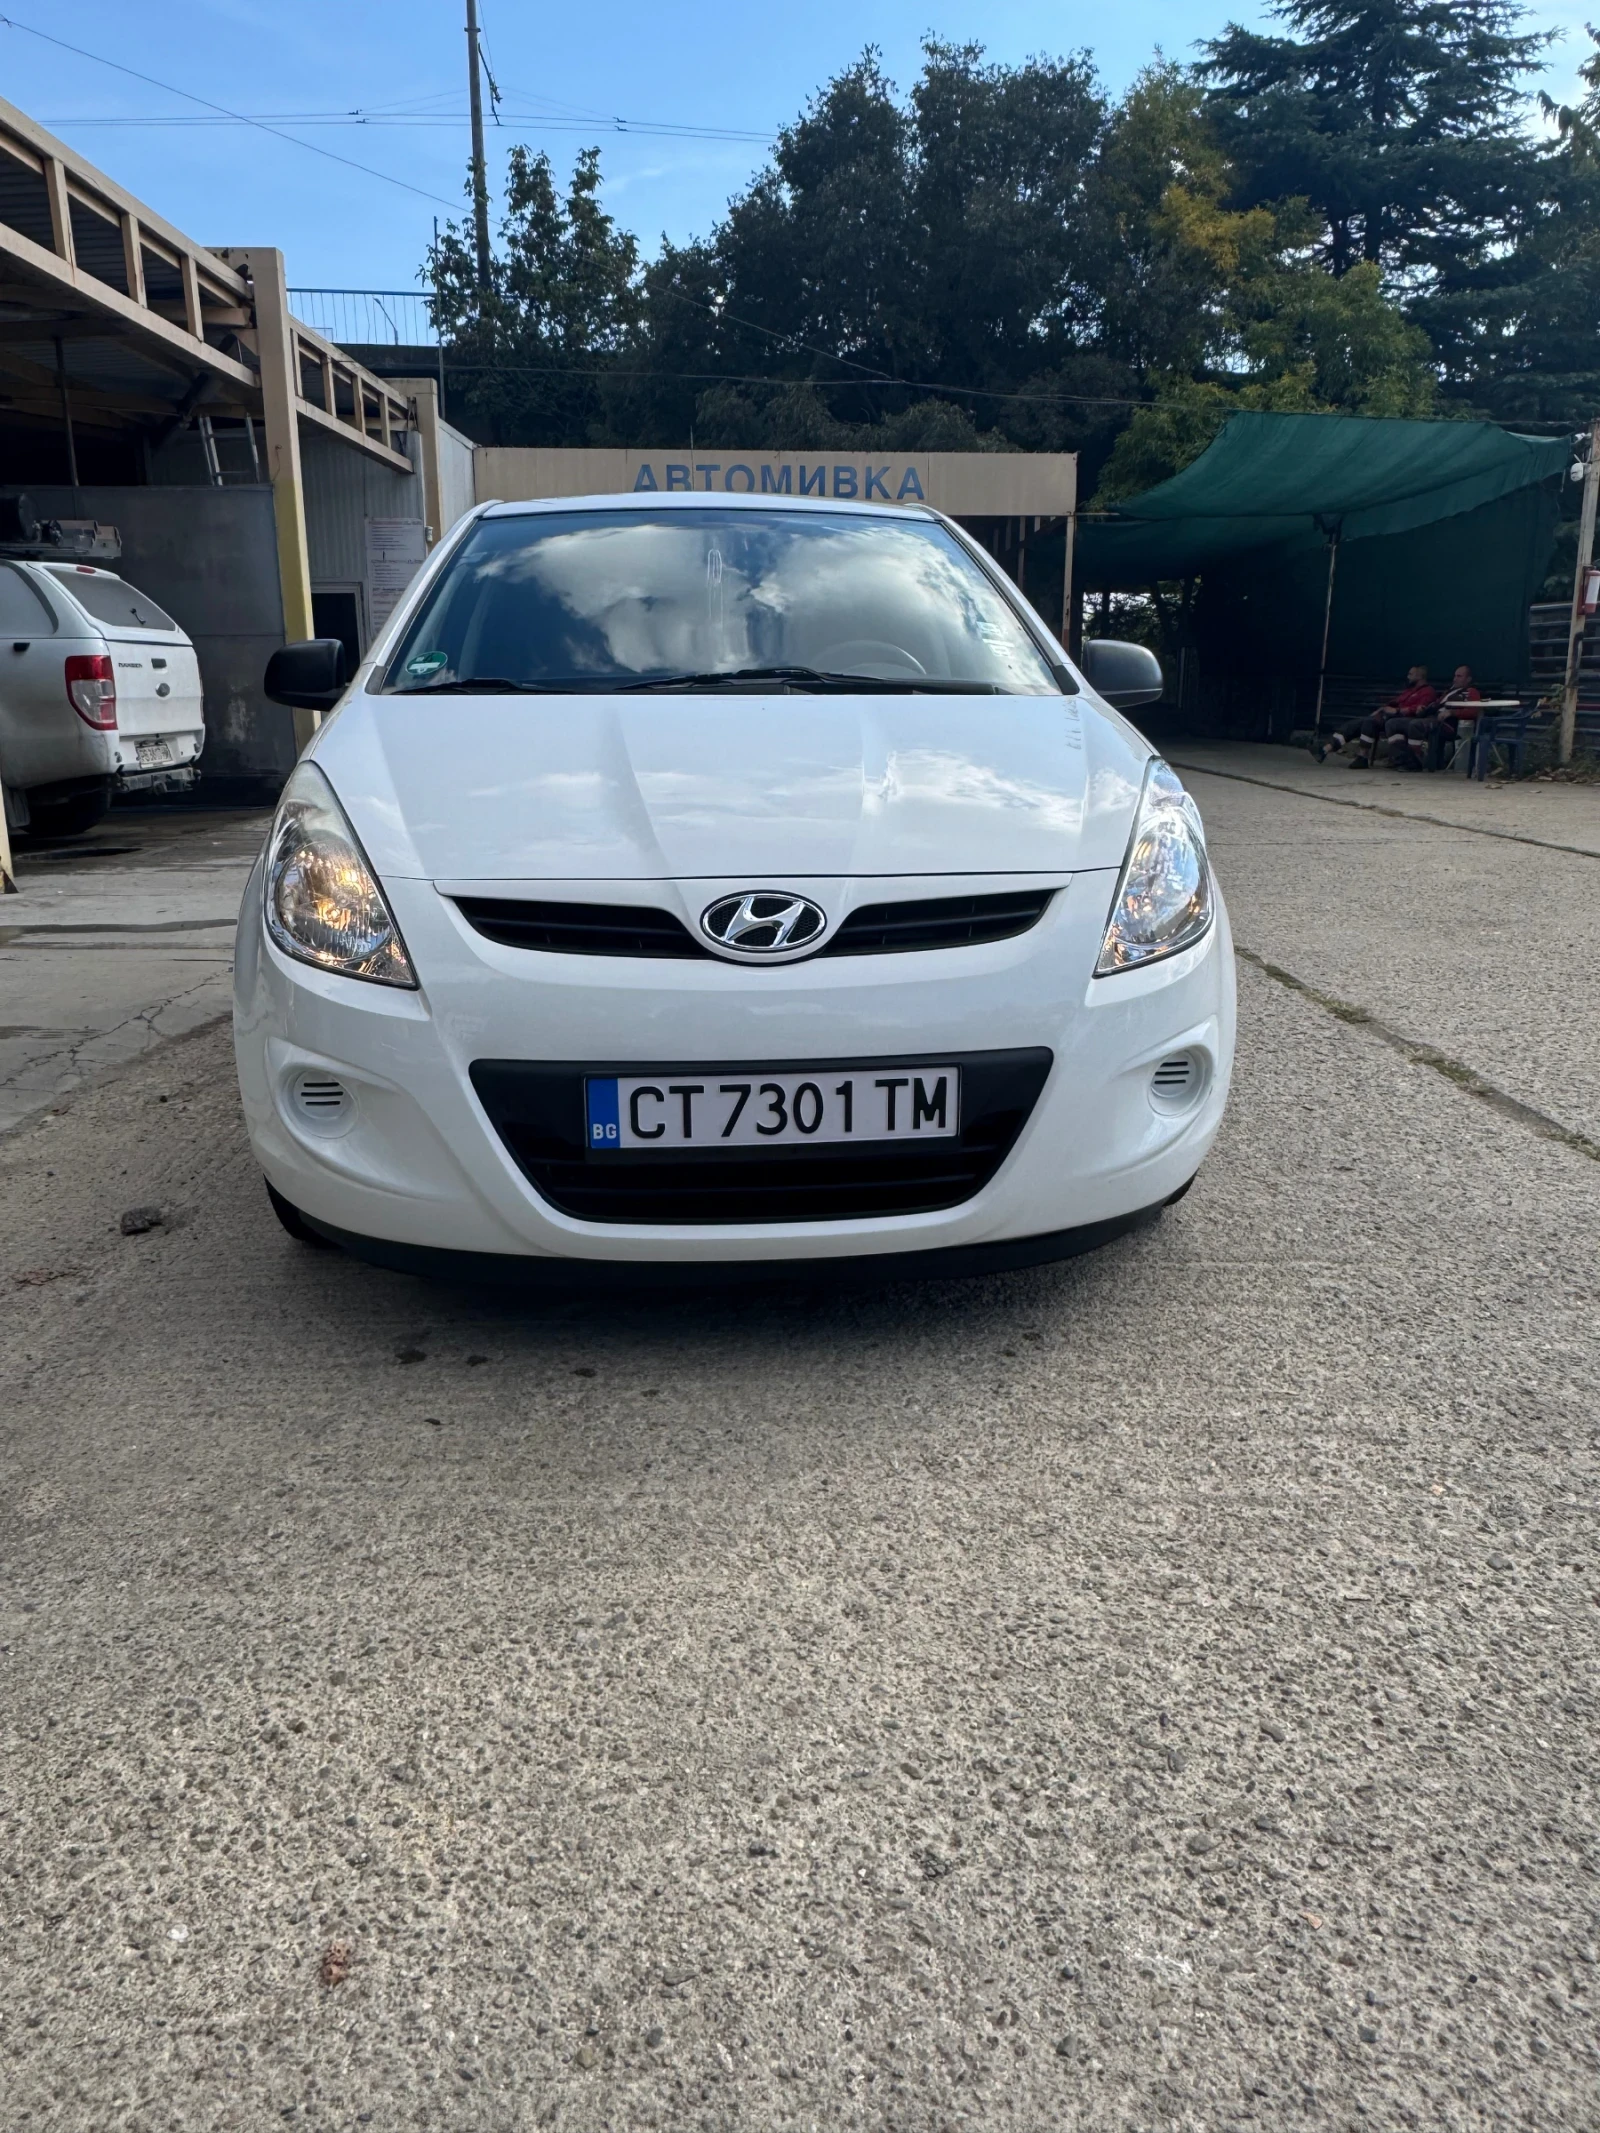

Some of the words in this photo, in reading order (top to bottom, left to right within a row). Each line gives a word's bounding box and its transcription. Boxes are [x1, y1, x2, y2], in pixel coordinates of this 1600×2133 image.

[633, 464, 925, 500] АВТОМИВКА
[630, 1086, 705, 1139] CT
[719, 1081, 853, 1138] 7301
[875, 1076, 948, 1132] TM
[592, 1123, 618, 1140] BG
